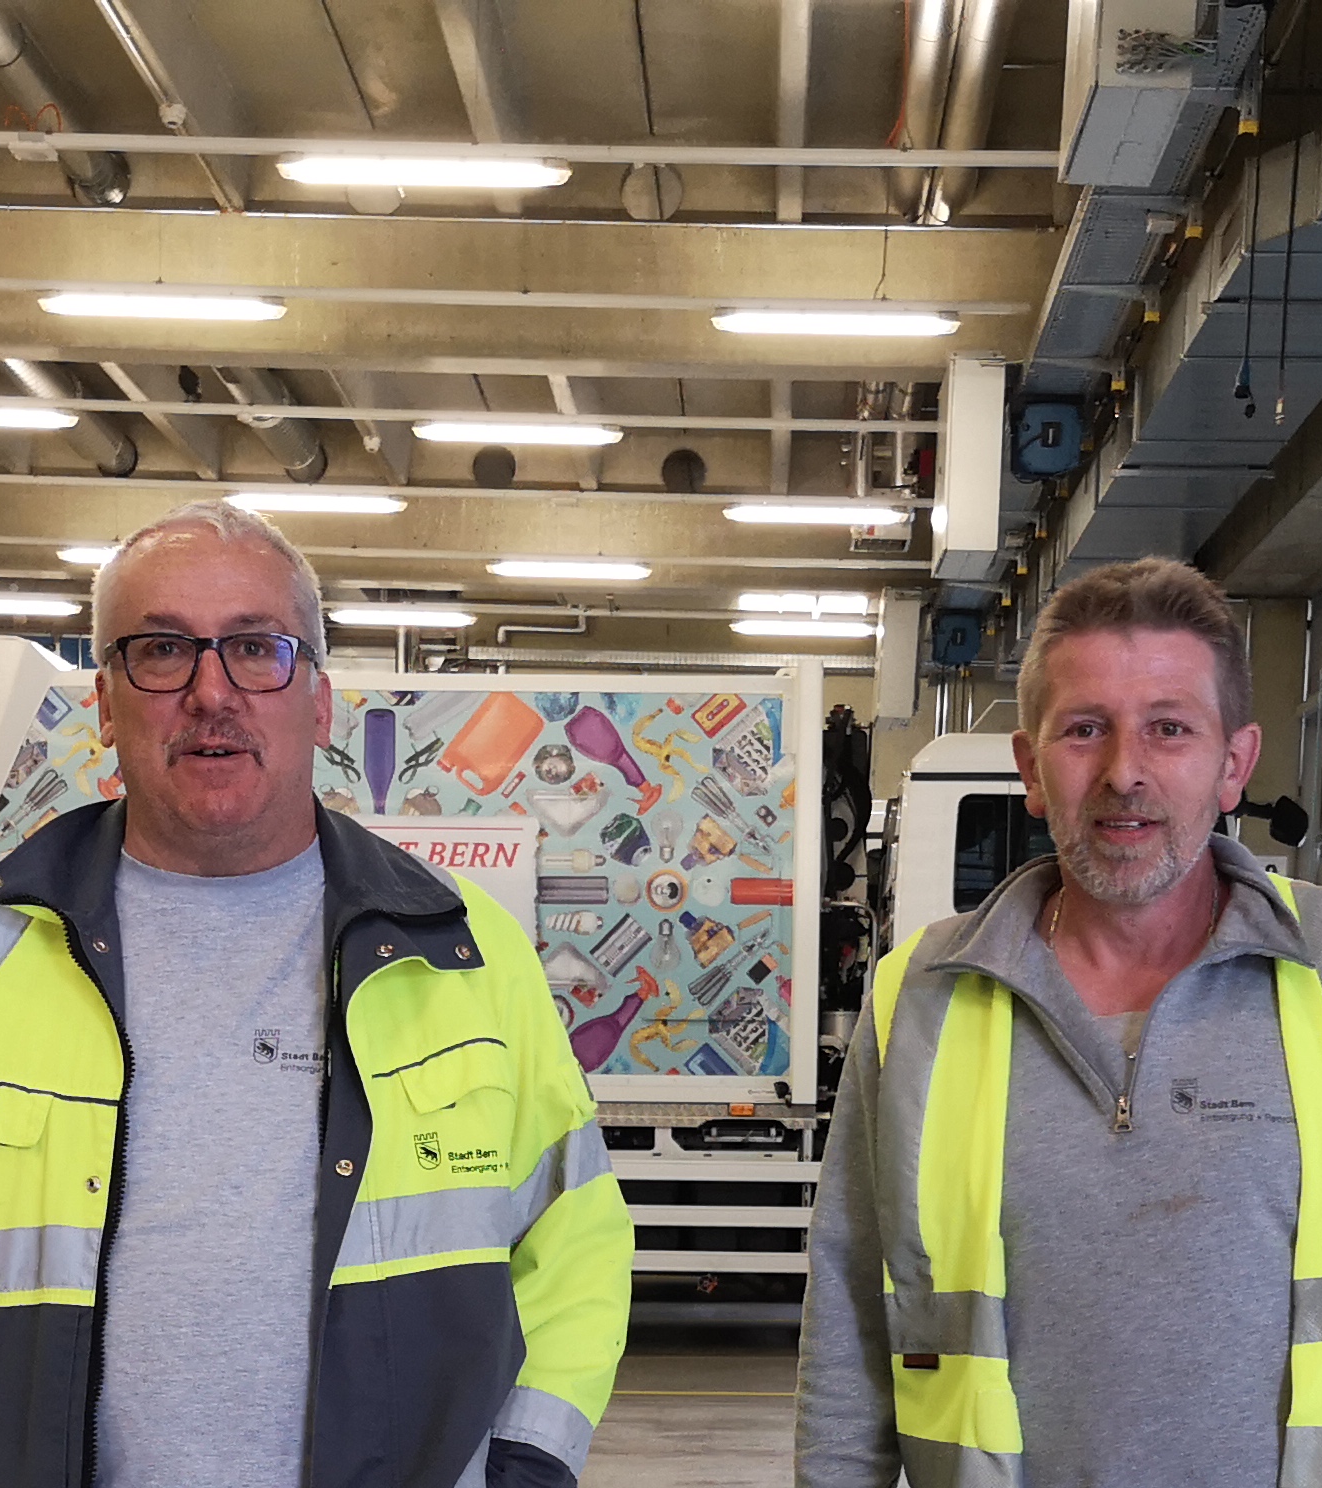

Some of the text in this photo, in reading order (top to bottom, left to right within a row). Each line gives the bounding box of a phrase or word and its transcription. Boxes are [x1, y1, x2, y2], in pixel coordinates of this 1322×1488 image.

[428, 842, 520, 868] BERN
[1199, 1100, 1228, 1109] Stadt
[447, 1148, 498, 1161] Stadt Bern
